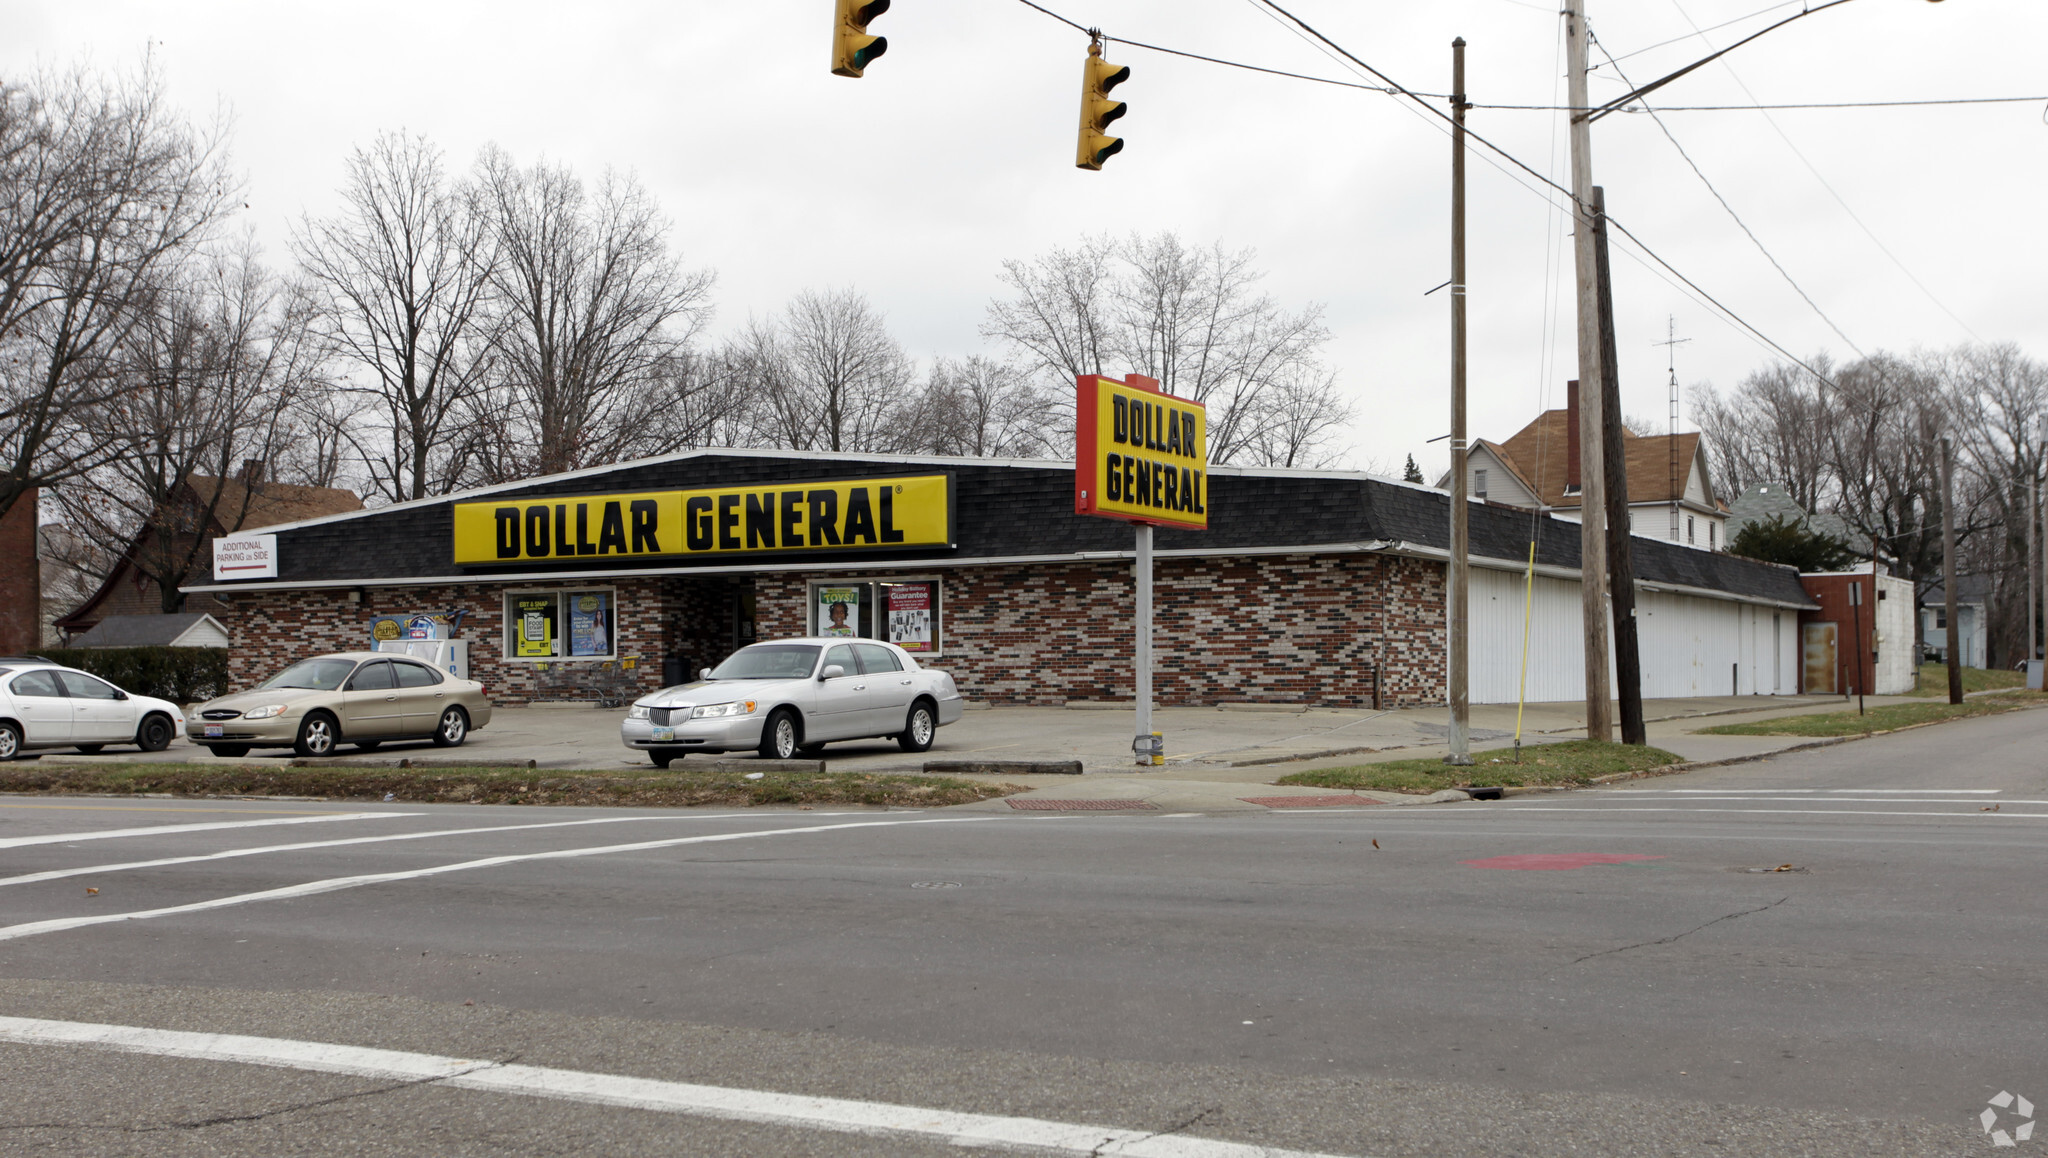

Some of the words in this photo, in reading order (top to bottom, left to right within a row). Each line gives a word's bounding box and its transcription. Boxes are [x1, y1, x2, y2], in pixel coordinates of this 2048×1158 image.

[1113, 393, 1196, 458] DOLLAR
[1107, 452, 1204, 514] GENERAL
[495, 499, 660, 559] DOLLAR
[686, 485, 904, 551] GENERAL
[222, 541, 263, 551] ADDITIONAL
[217, 552, 245, 562] PARKING
[253, 551, 268, 560] SIDE
[824, 593, 854, 603] TOYS!
[891, 592, 928, 600] Guarantee
